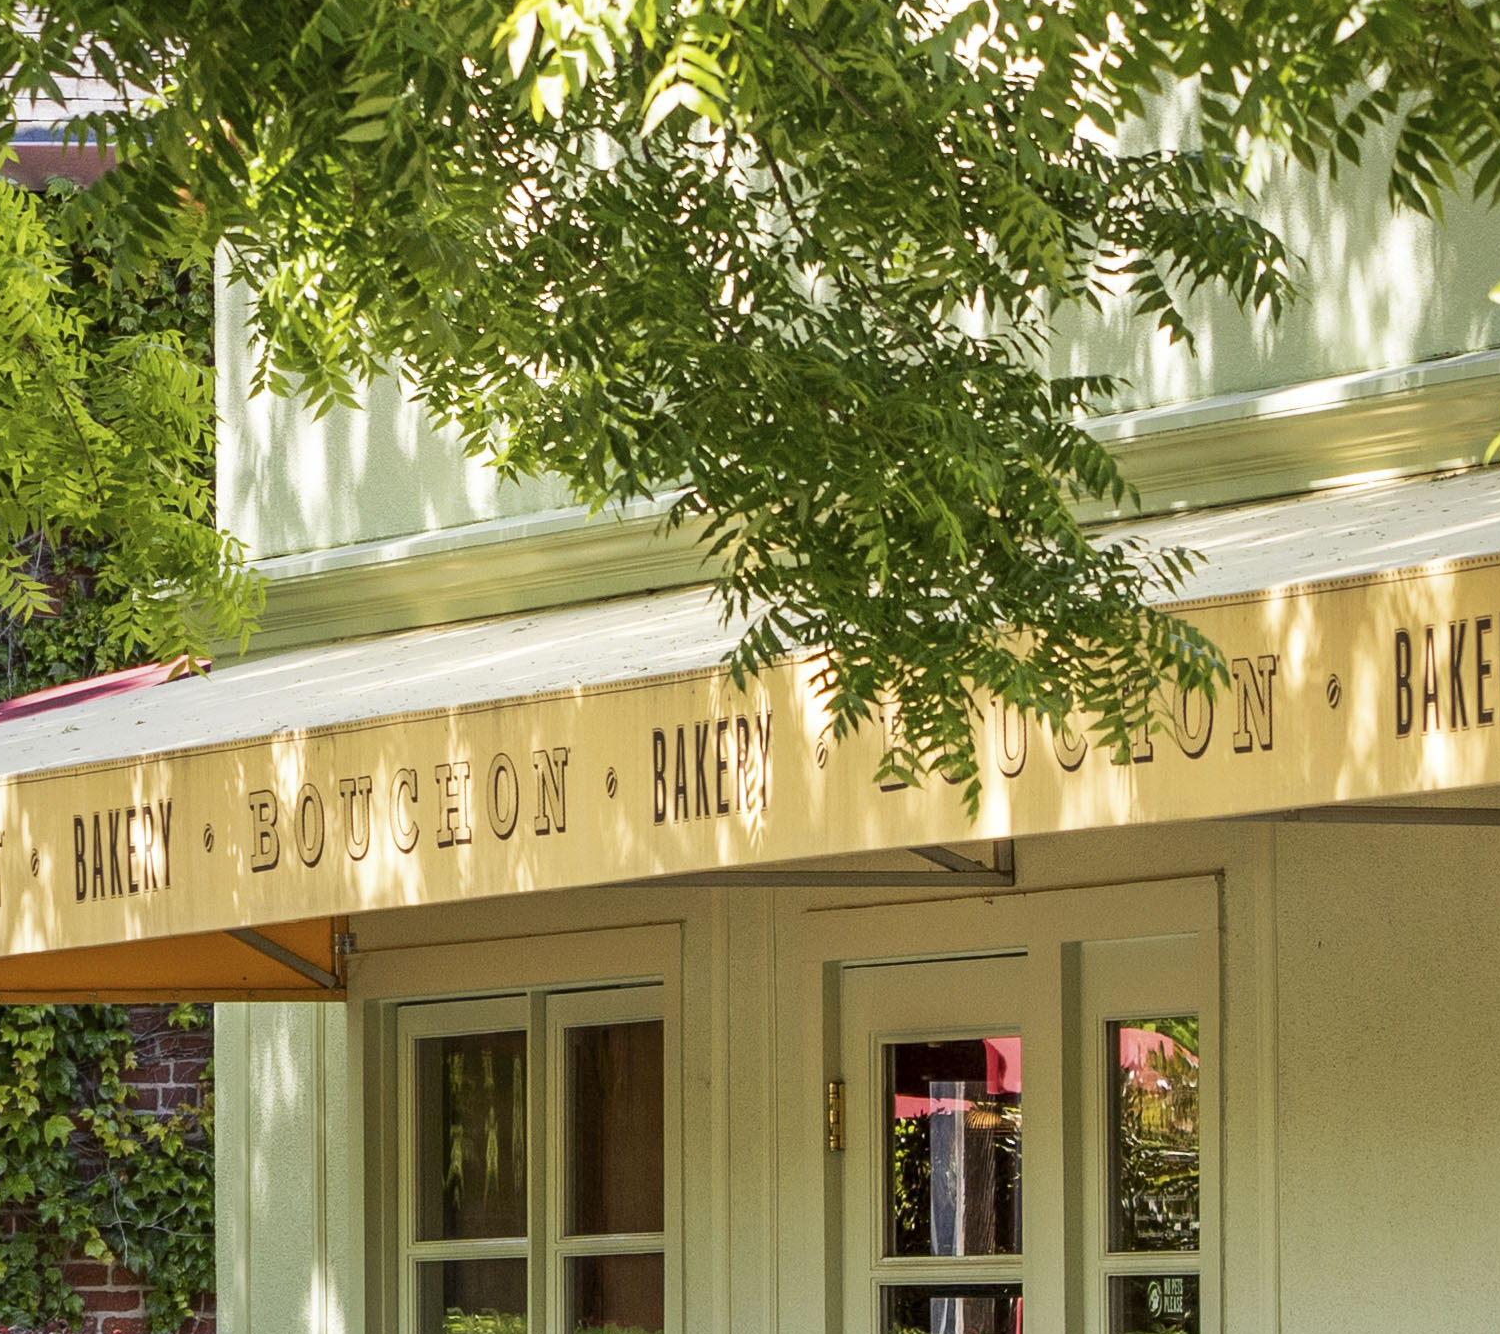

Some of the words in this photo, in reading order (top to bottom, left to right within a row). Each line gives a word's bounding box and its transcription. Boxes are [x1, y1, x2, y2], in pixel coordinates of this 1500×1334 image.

[73, 798, 173, 904] BAKERY
[249, 748, 569, 873] BOUCHON
[652, 710, 773, 826] BAKERY
[879, 655, 1276, 792] BUCHON
